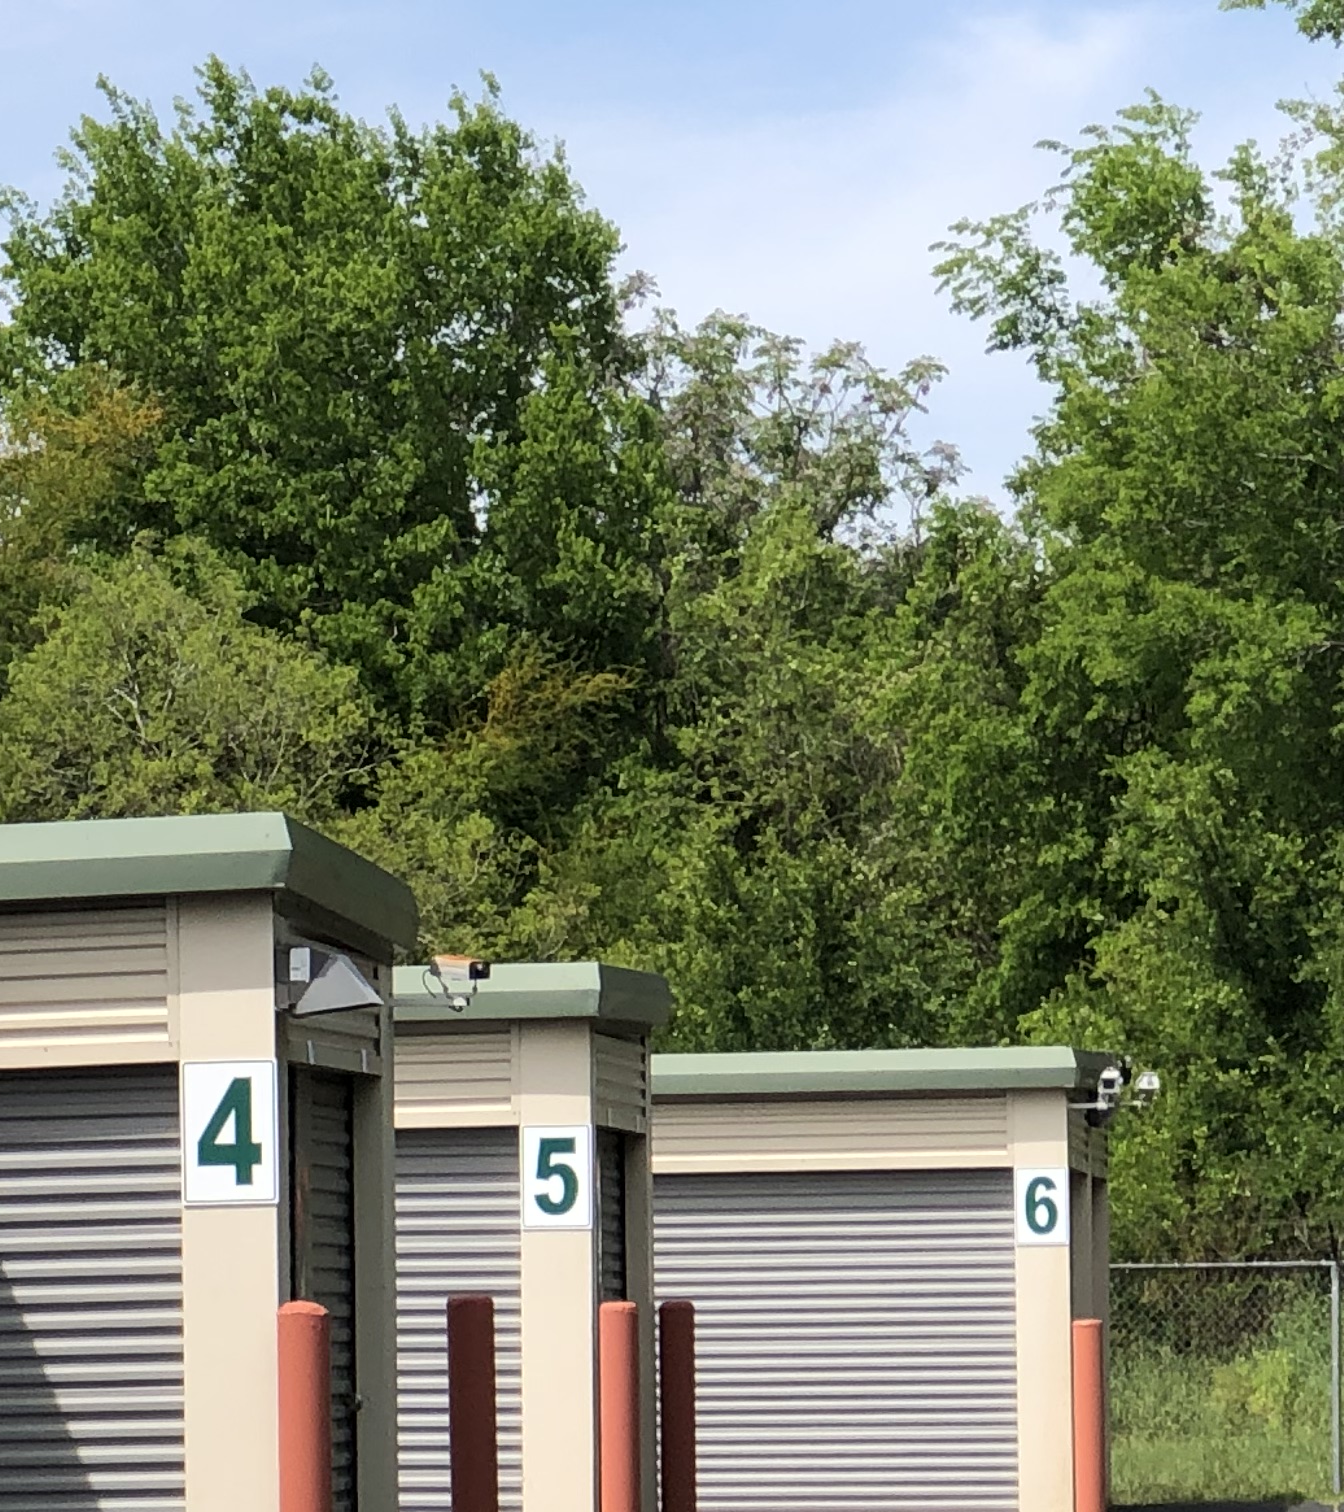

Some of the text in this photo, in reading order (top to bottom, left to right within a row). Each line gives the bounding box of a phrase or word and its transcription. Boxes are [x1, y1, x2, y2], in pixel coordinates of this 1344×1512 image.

[197, 1077, 262, 1186] 4
[534, 1137, 579, 1215] 5
[1025, 1176, 1058, 1235] 6
